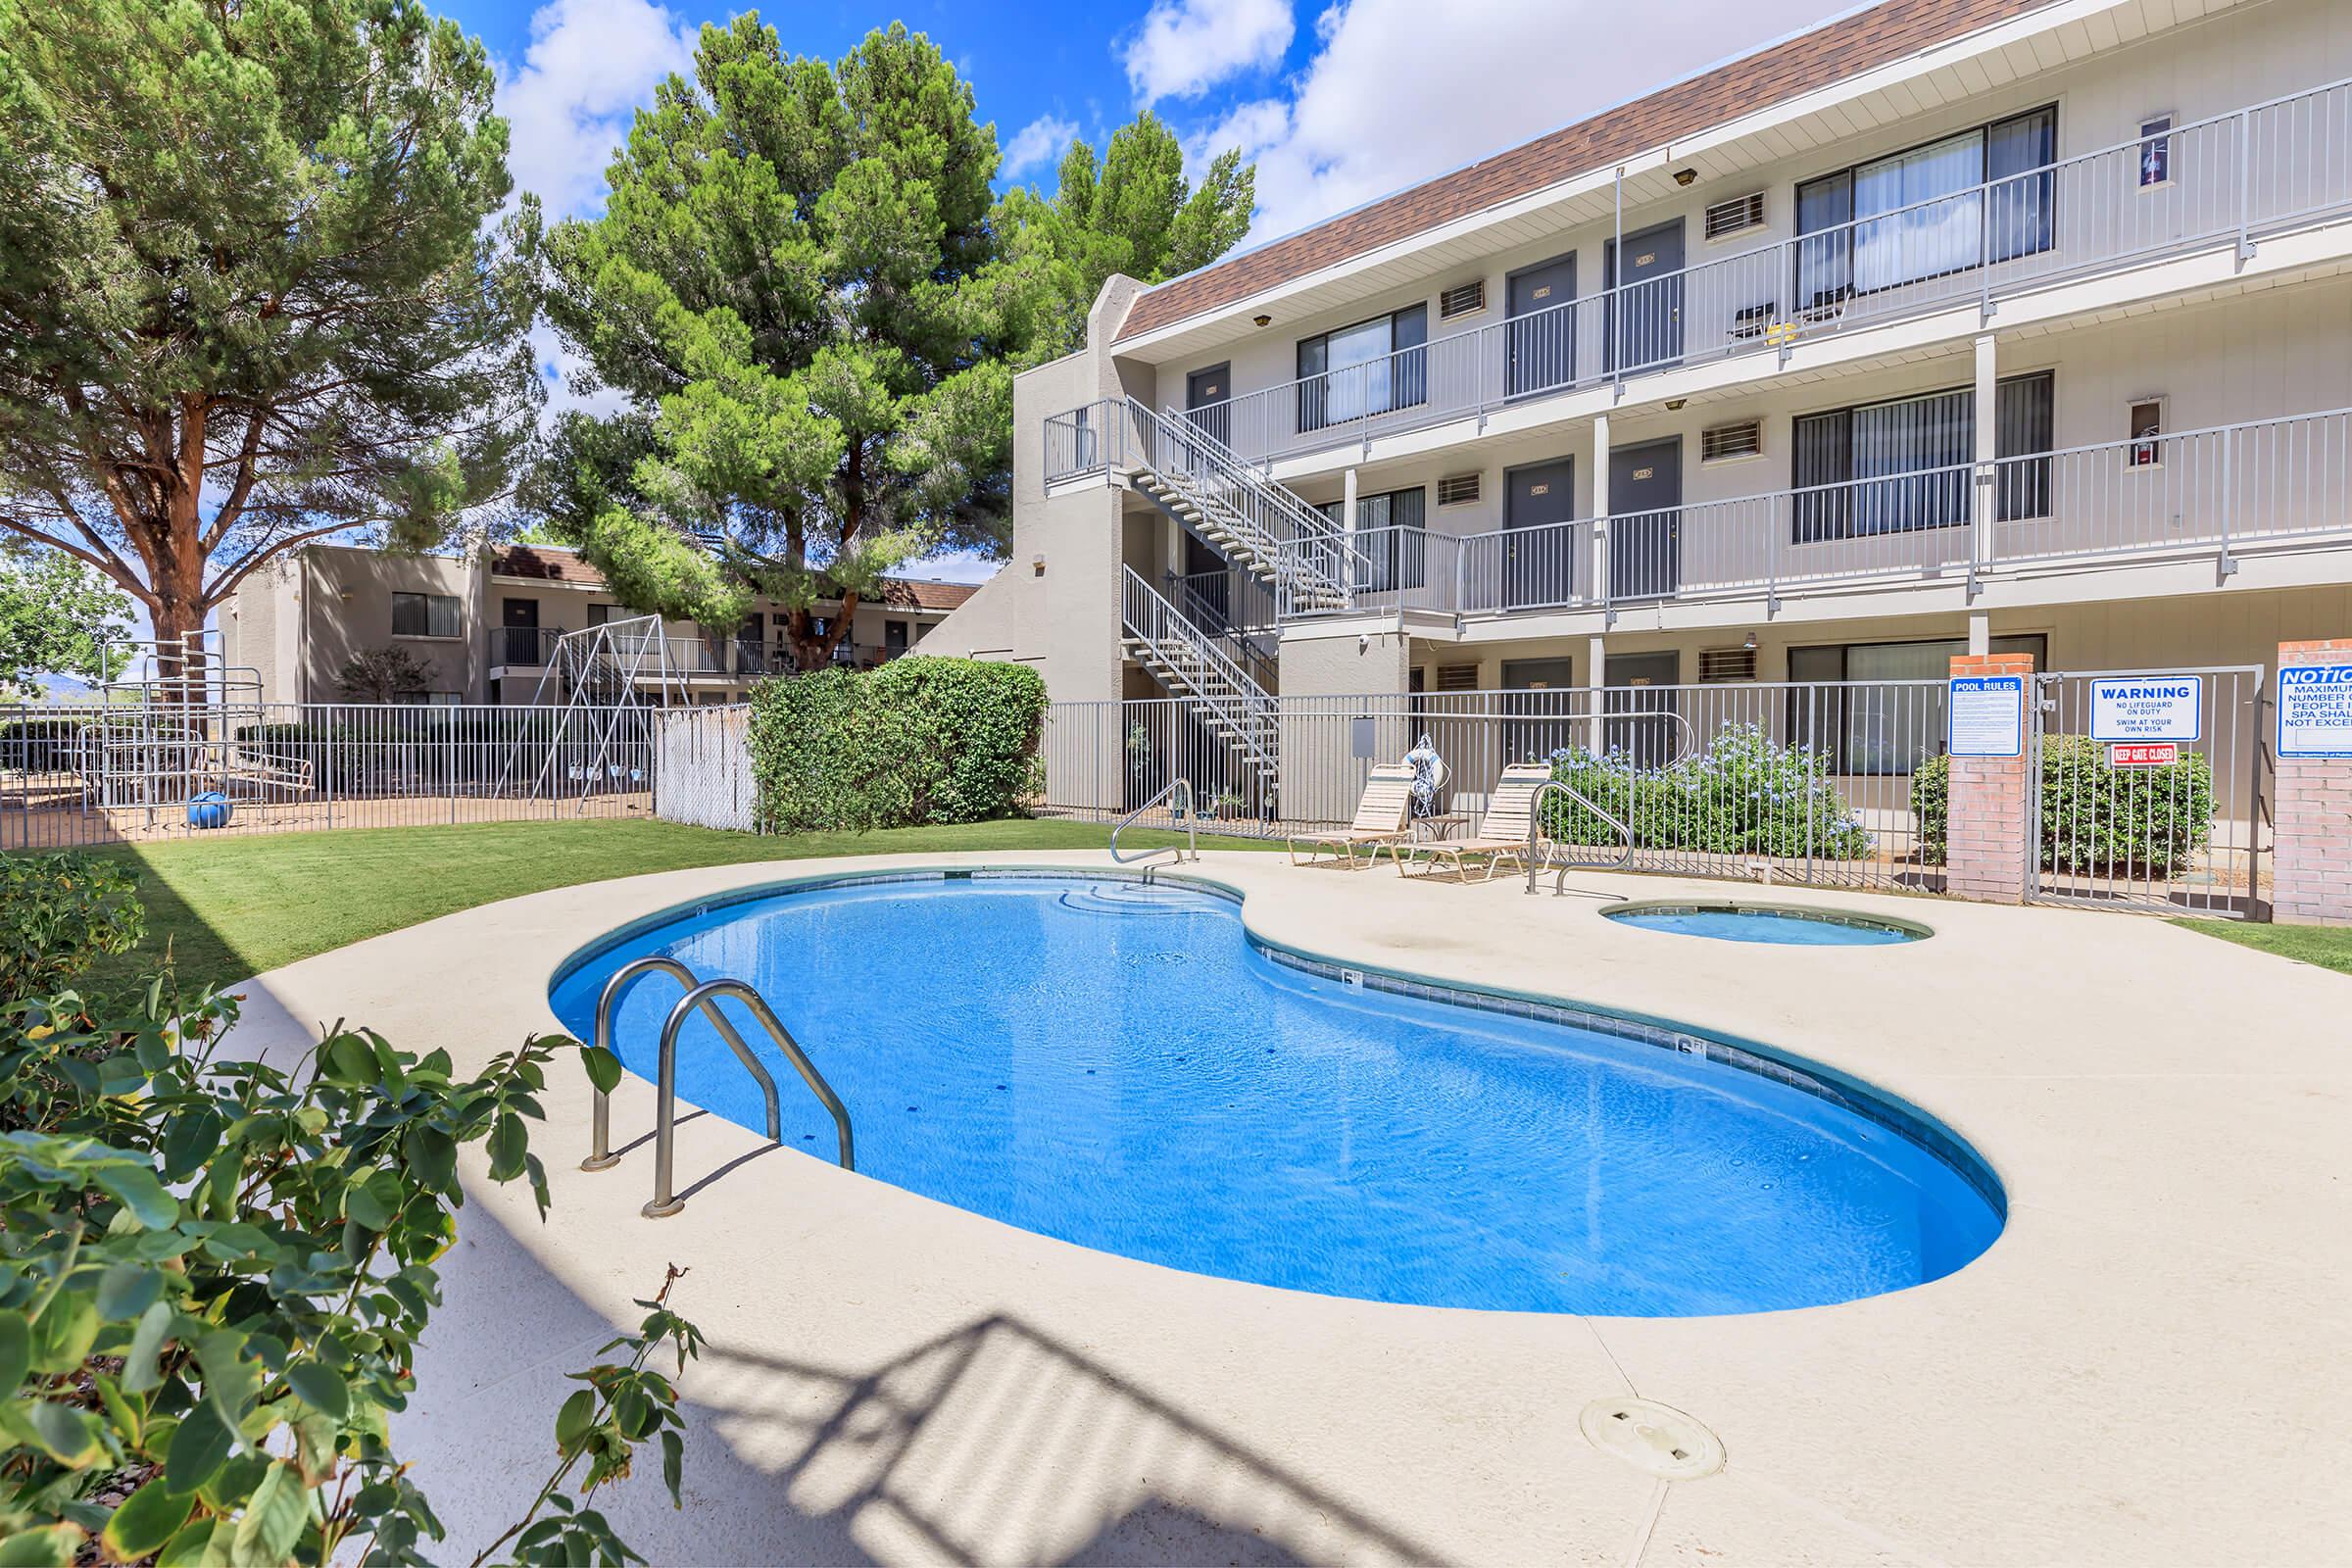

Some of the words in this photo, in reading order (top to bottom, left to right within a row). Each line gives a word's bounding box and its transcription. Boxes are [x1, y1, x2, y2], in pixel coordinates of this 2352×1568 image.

[1984, 682, 2016, 691] RULES
[2101, 687, 2189, 699] WARNING
[2115, 750, 2132, 760] KEEP
[2132, 749, 2148, 760] GATE
[2148, 748, 2174, 760] CLOSED
